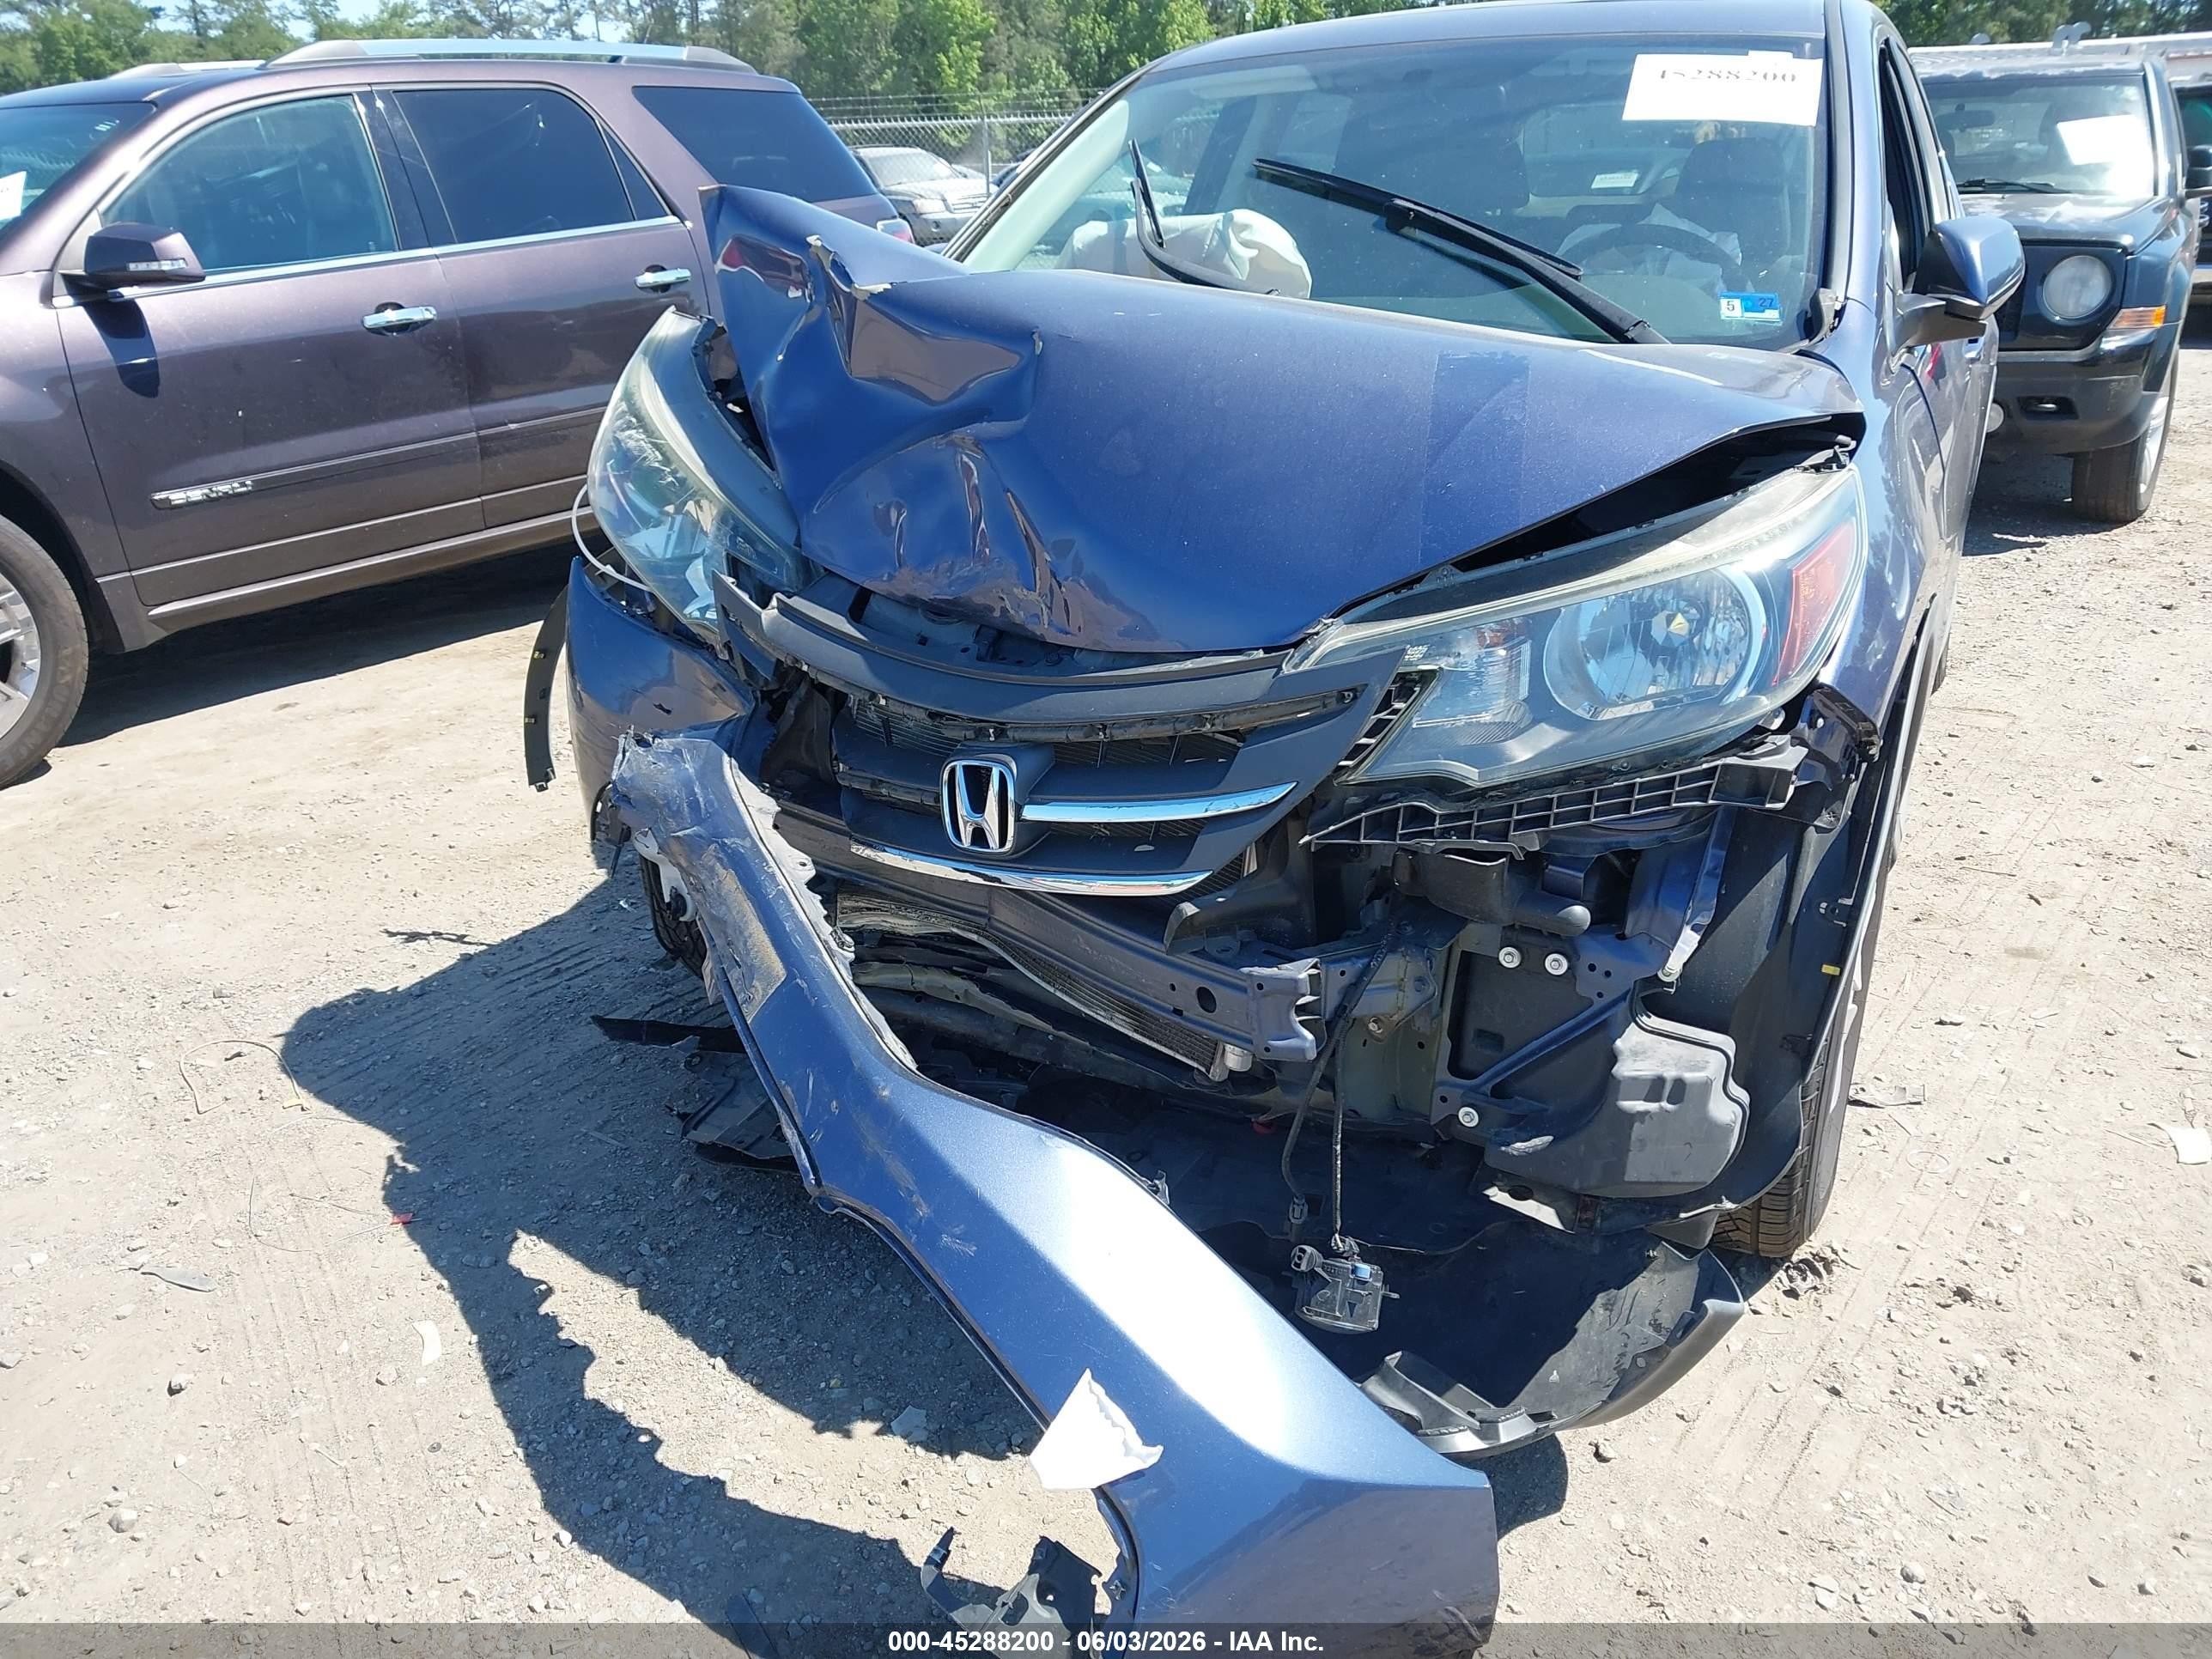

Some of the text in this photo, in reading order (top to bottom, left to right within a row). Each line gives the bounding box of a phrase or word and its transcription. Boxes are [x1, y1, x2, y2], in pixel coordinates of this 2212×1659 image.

[1726, 297, 1774, 312] 5 27
[168, 480, 253, 505] DENALI
